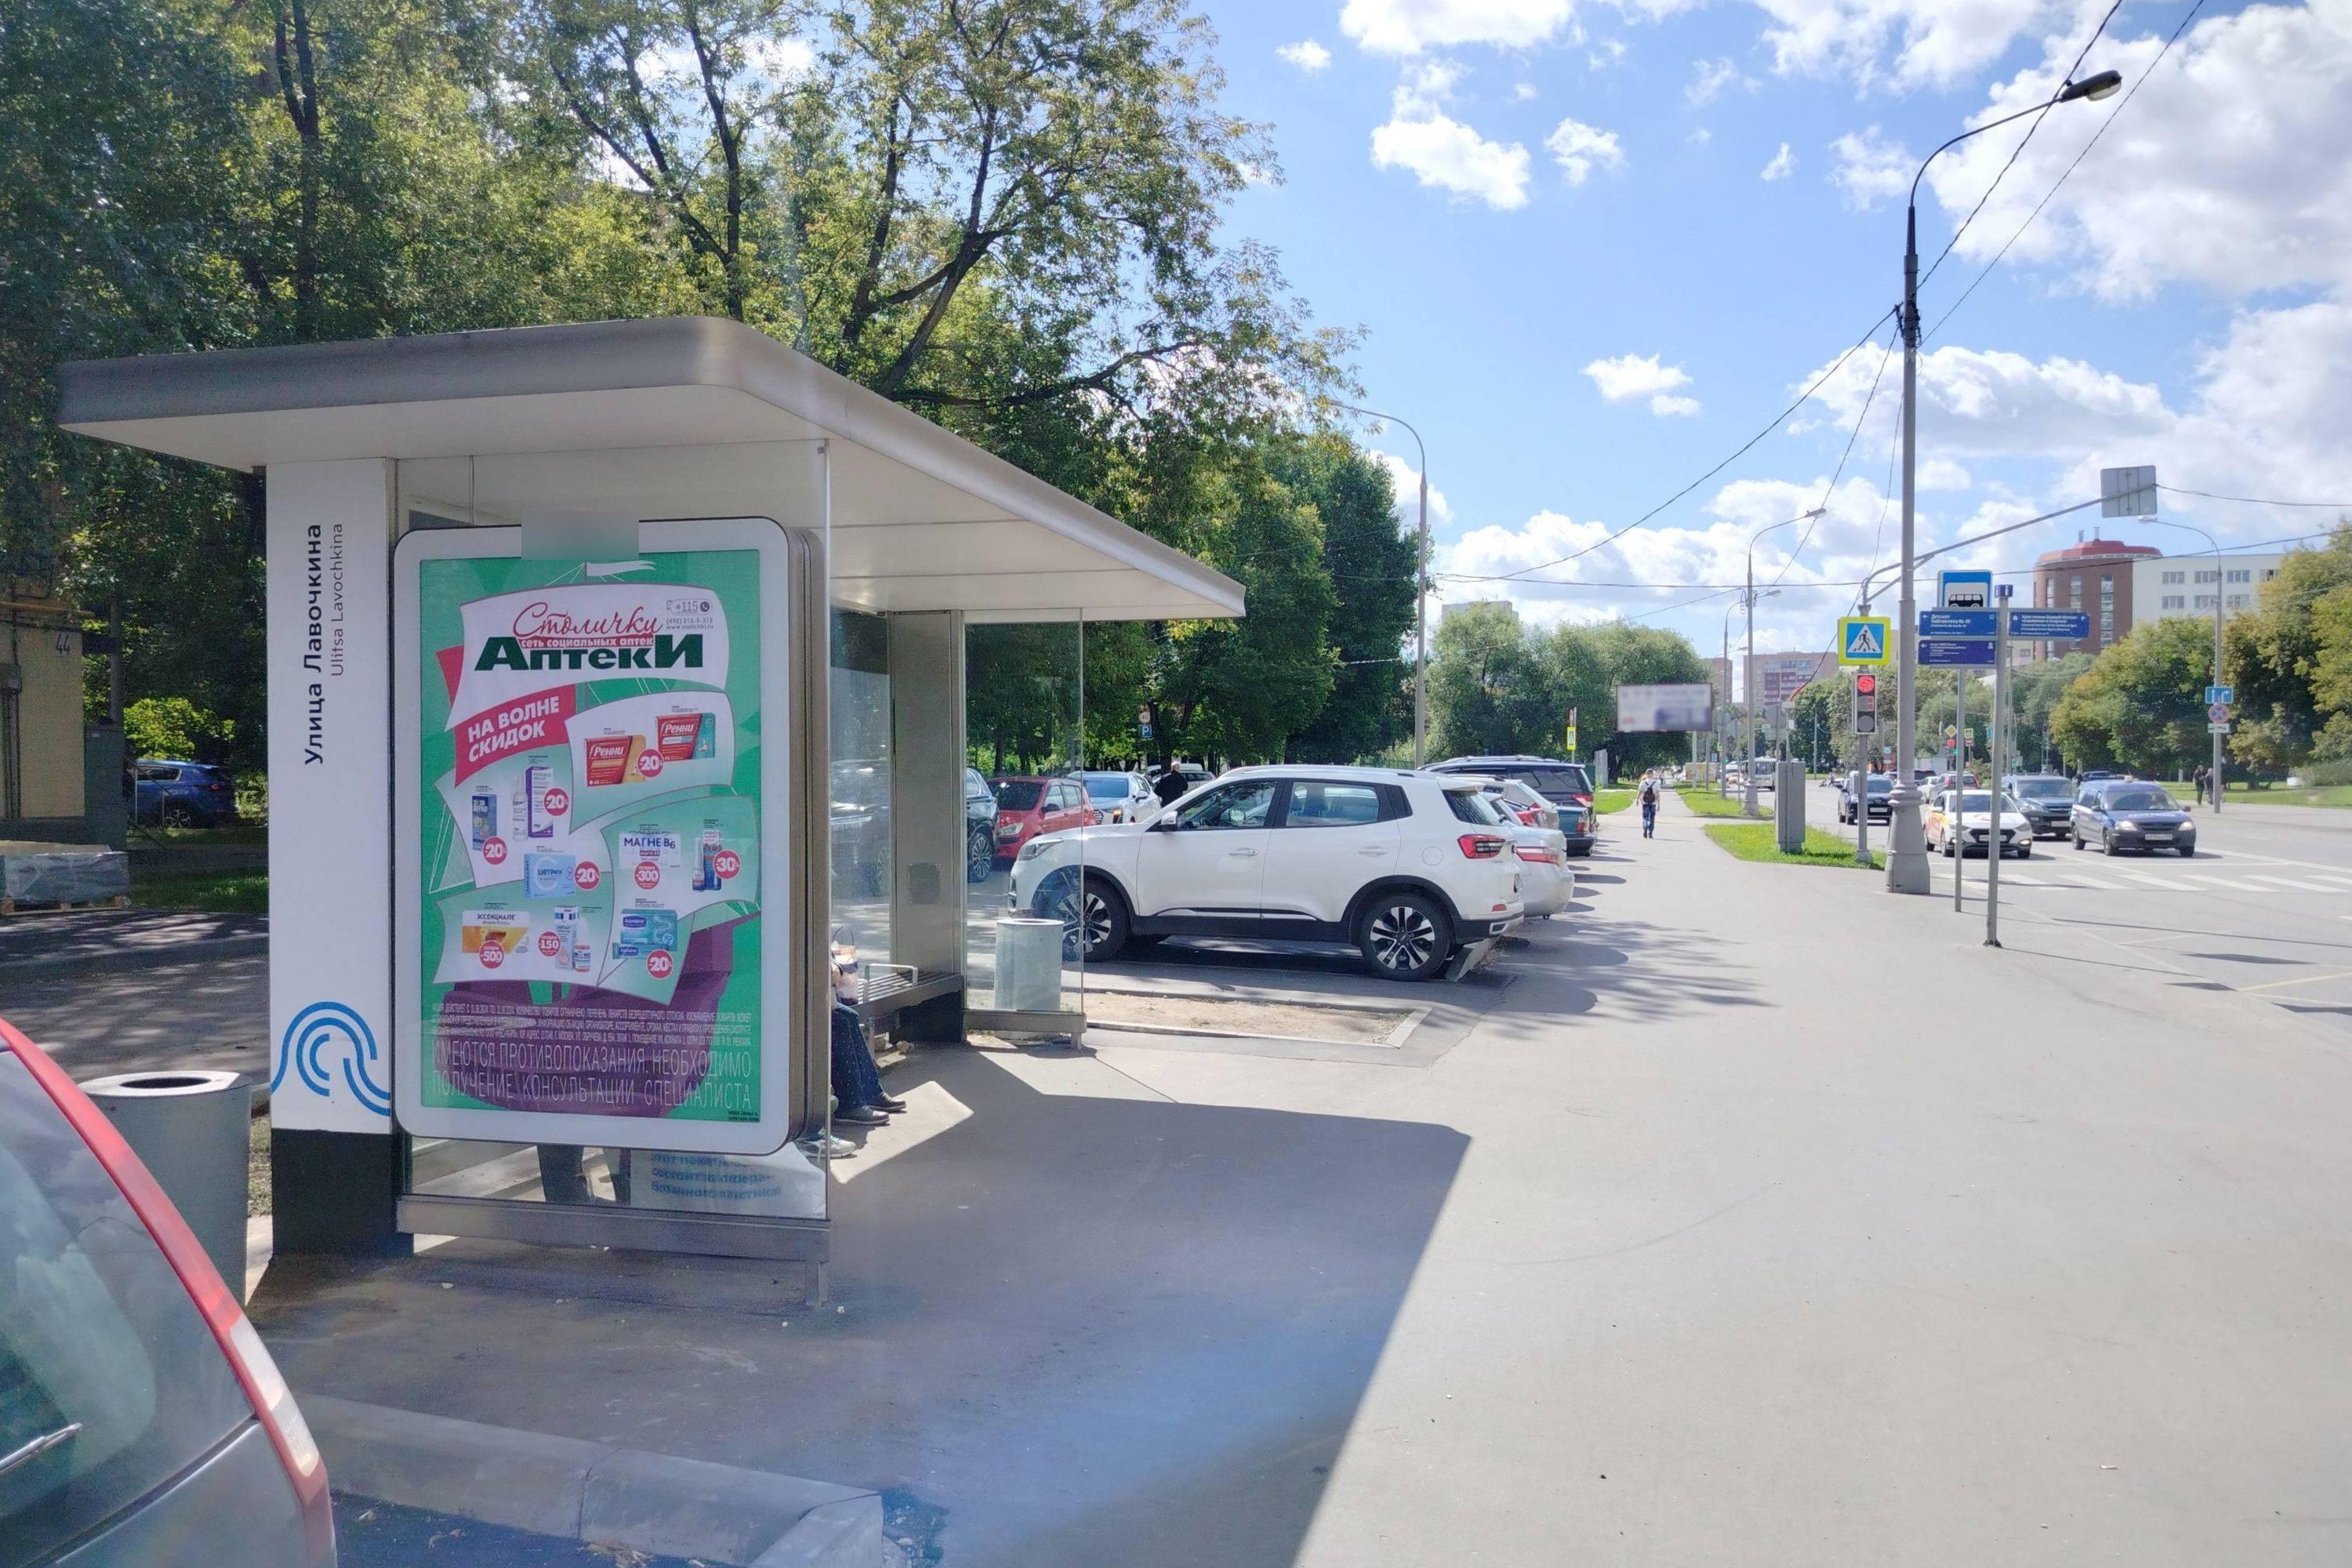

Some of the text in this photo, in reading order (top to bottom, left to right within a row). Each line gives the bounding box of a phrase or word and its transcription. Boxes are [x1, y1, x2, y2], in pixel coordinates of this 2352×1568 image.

[330, 523, 344, 676] Ulitsa Lavochkina
[513, 602, 663, 637] Столички
[56, 633, 71, 655] 44
[304, 524, 325, 766] Улица Лавочкина
[521, 637, 654, 648] сеть социальных аптек
[467, 696, 560, 743] НА ВОЛНЕ
[468, 720, 546, 763] СКИДОК
[624, 837, 662, 847] МАГНЕ
[432, 1042, 751, 1078] ИМЕЮТСЯ ПРОТИВОПОКАЗАНИЯ. НЕОБХОДИМО
[433, 1069, 752, 1109] ПОЛУЧЕНИЕ КОНСУЛЬТАЦИИ СПЕЦИАЛИСТА
